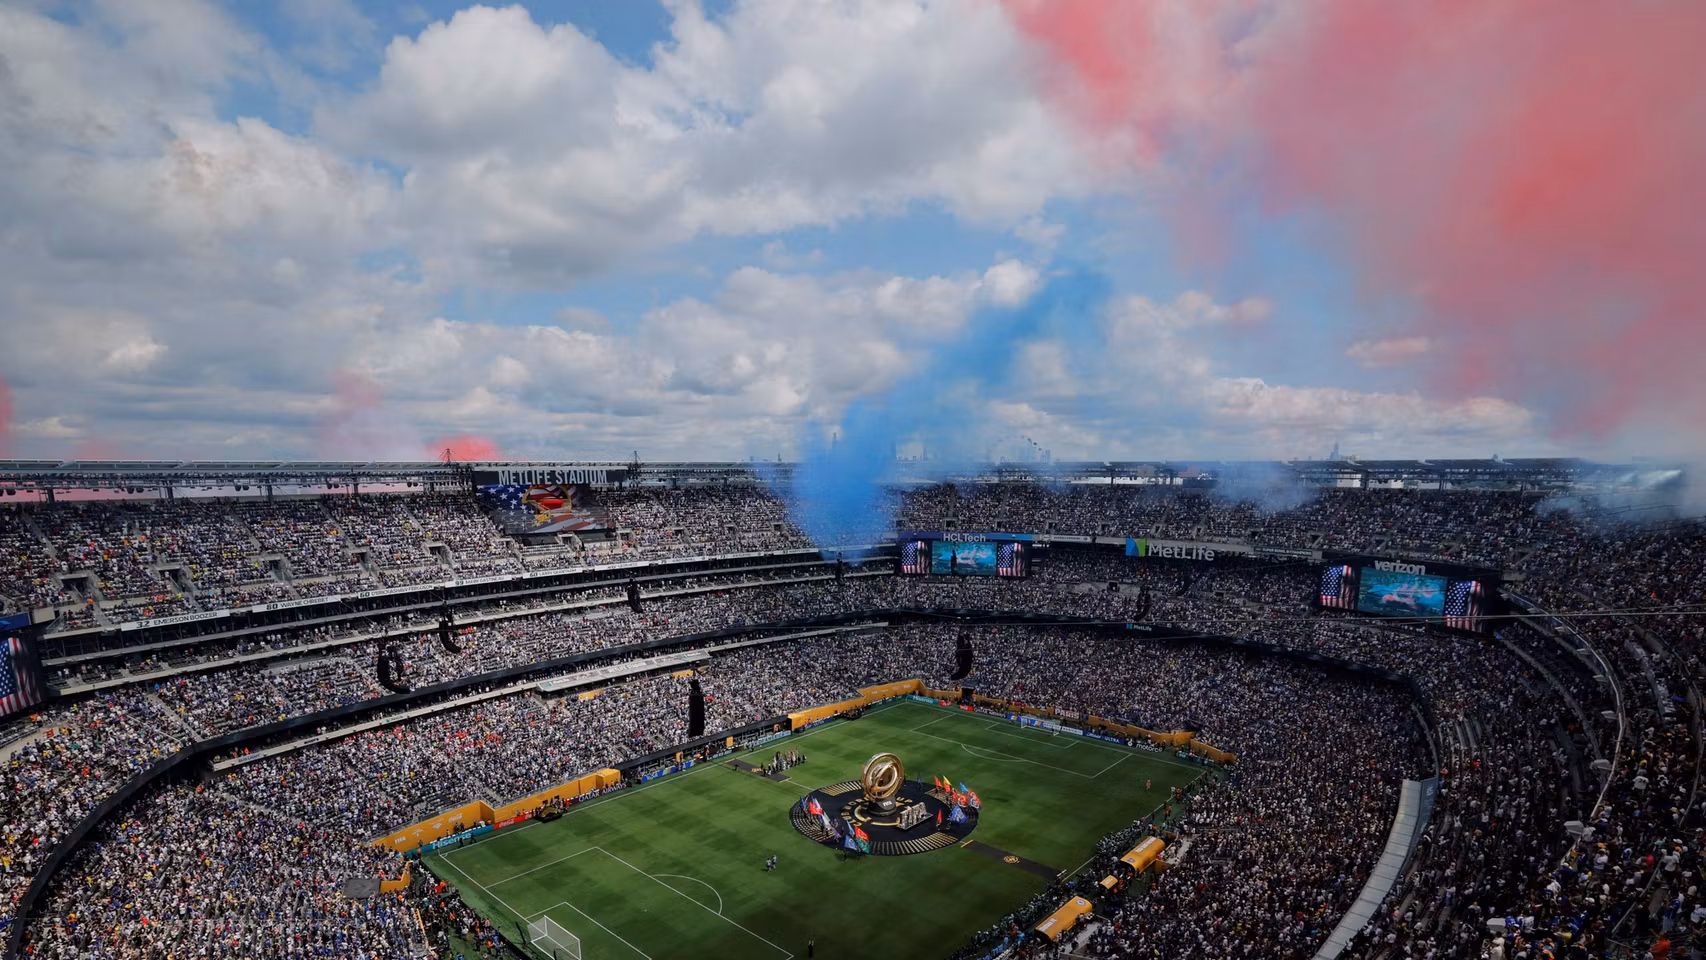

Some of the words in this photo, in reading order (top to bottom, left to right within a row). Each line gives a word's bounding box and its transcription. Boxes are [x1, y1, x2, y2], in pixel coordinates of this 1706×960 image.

[498, 470, 552, 486] METLIFE
[555, 470, 608, 484] STADIUM
[943, 533, 986, 542] HCLTech
[1148, 543, 1215, 562] MetLife
[1374, 560, 1426, 576] verizon
[154, 616, 189, 626] EMERSON
[190, 612, 218, 621] BOOZER
[1055, 708, 1080, 719] PARIS
[579, 791, 600, 802] QATAR
[602, 782, 627, 795] AIRWAYS
[432, 833, 472, 849] Hisense
